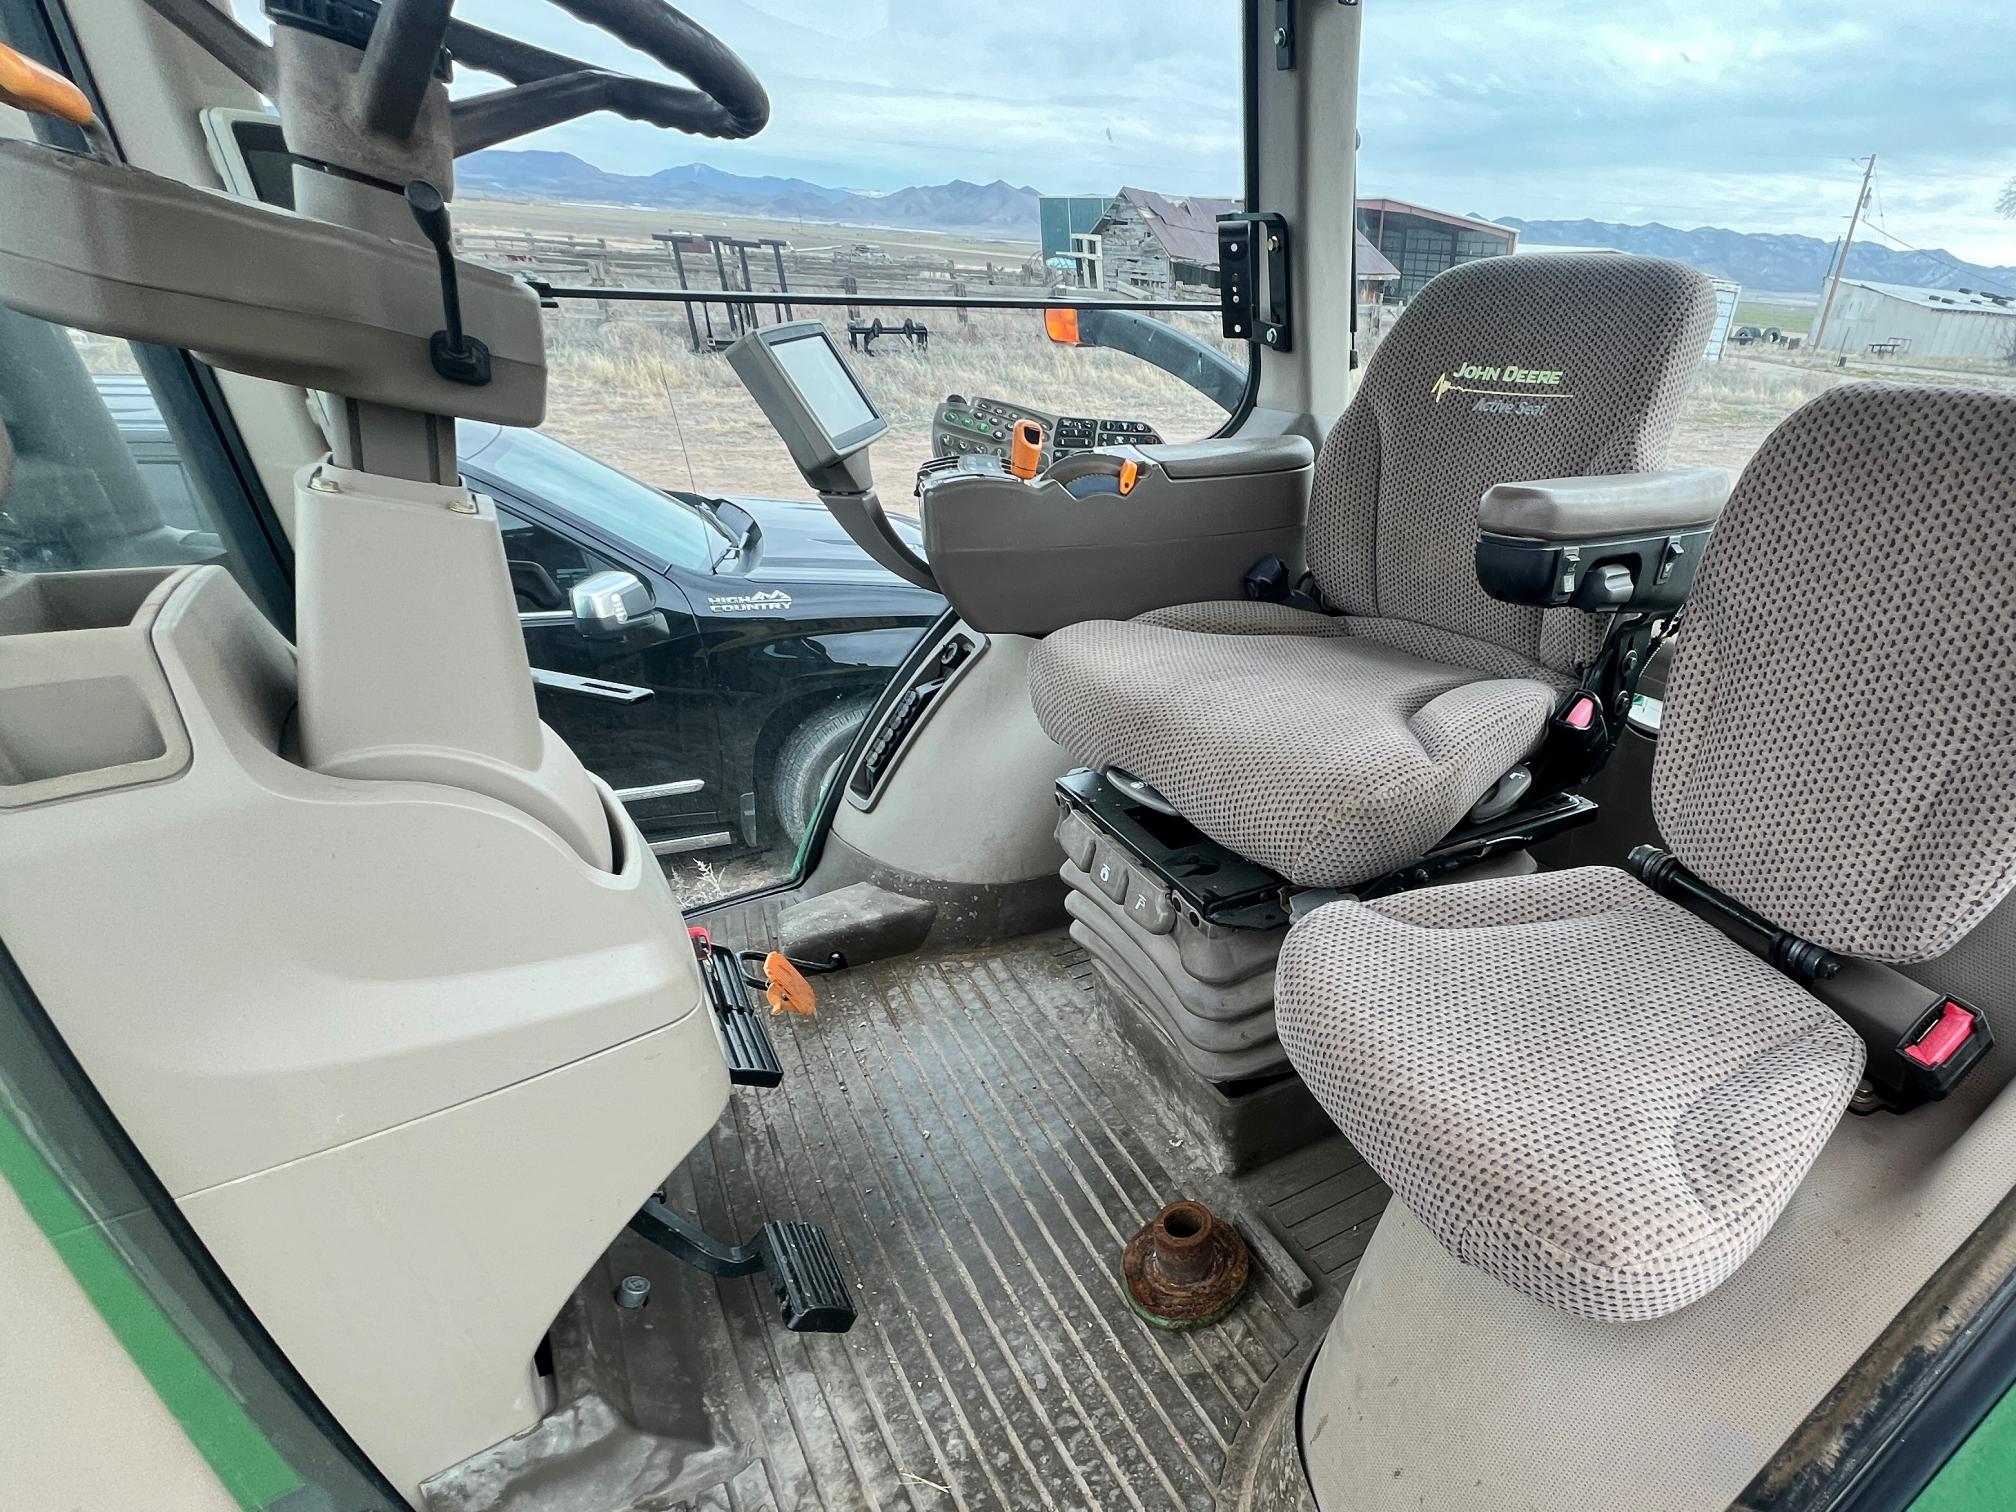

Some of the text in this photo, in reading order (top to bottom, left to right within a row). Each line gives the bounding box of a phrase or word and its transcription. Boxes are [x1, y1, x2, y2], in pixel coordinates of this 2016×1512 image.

[1453, 362, 1563, 385] JOHN DEERE
[1472, 398, 1548, 416] Active Seat
[708, 596, 751, 604] HIGH
[709, 602, 792, 613] COUNTRY
